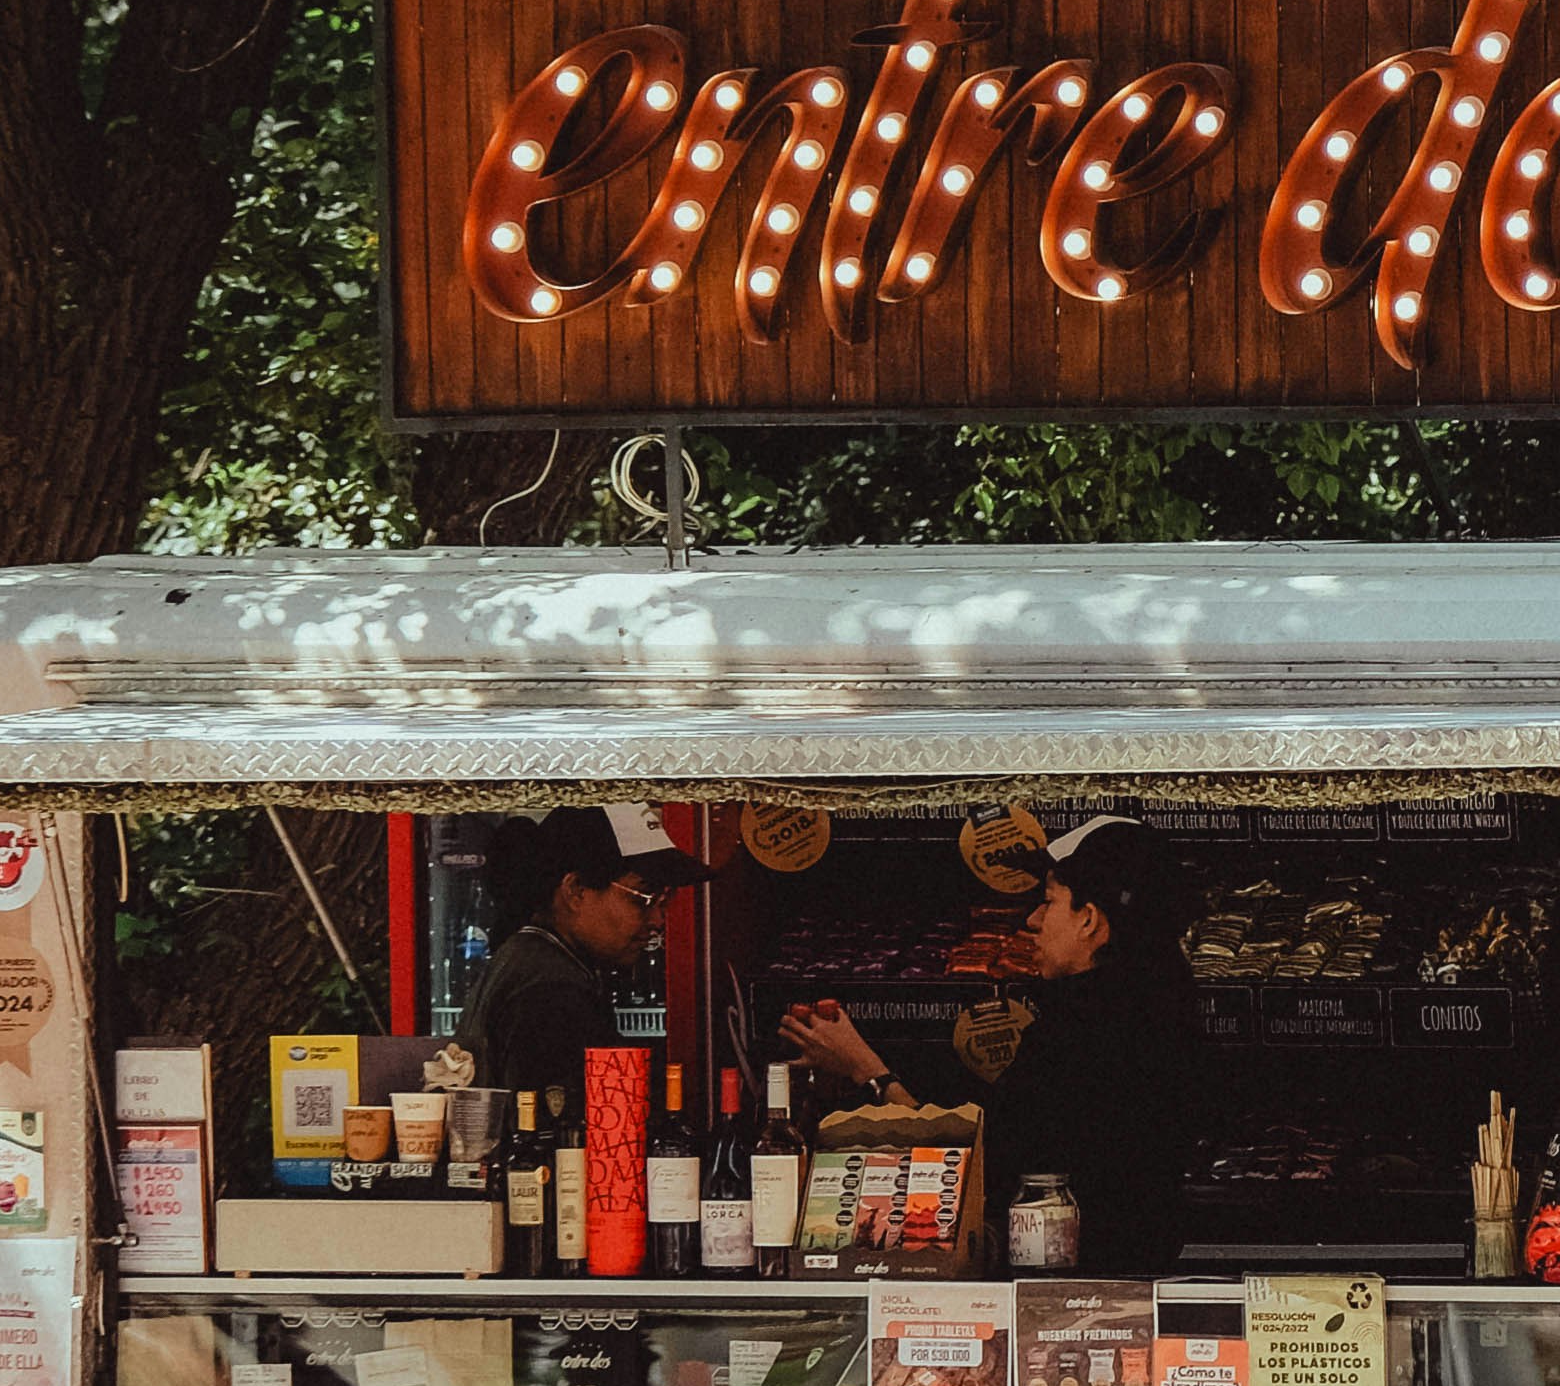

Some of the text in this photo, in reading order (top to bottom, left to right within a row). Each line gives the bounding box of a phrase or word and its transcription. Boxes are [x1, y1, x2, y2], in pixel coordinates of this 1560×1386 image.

[1459, 792, 1496, 811] NEGRO
[1421, 1005, 1483, 1032] CONITOS
[1251, 1311, 1316, 1322] RESOLUCIÓN
[1270, 1342, 1359, 1353] PROHIBIDOS
[1258, 1354, 1371, 1369] LOS PLÁSTICOS
[1171, 1365, 1233, 1381] ¿Cómo te
[1271, 1372, 1359, 1384] DE UN SOLO
